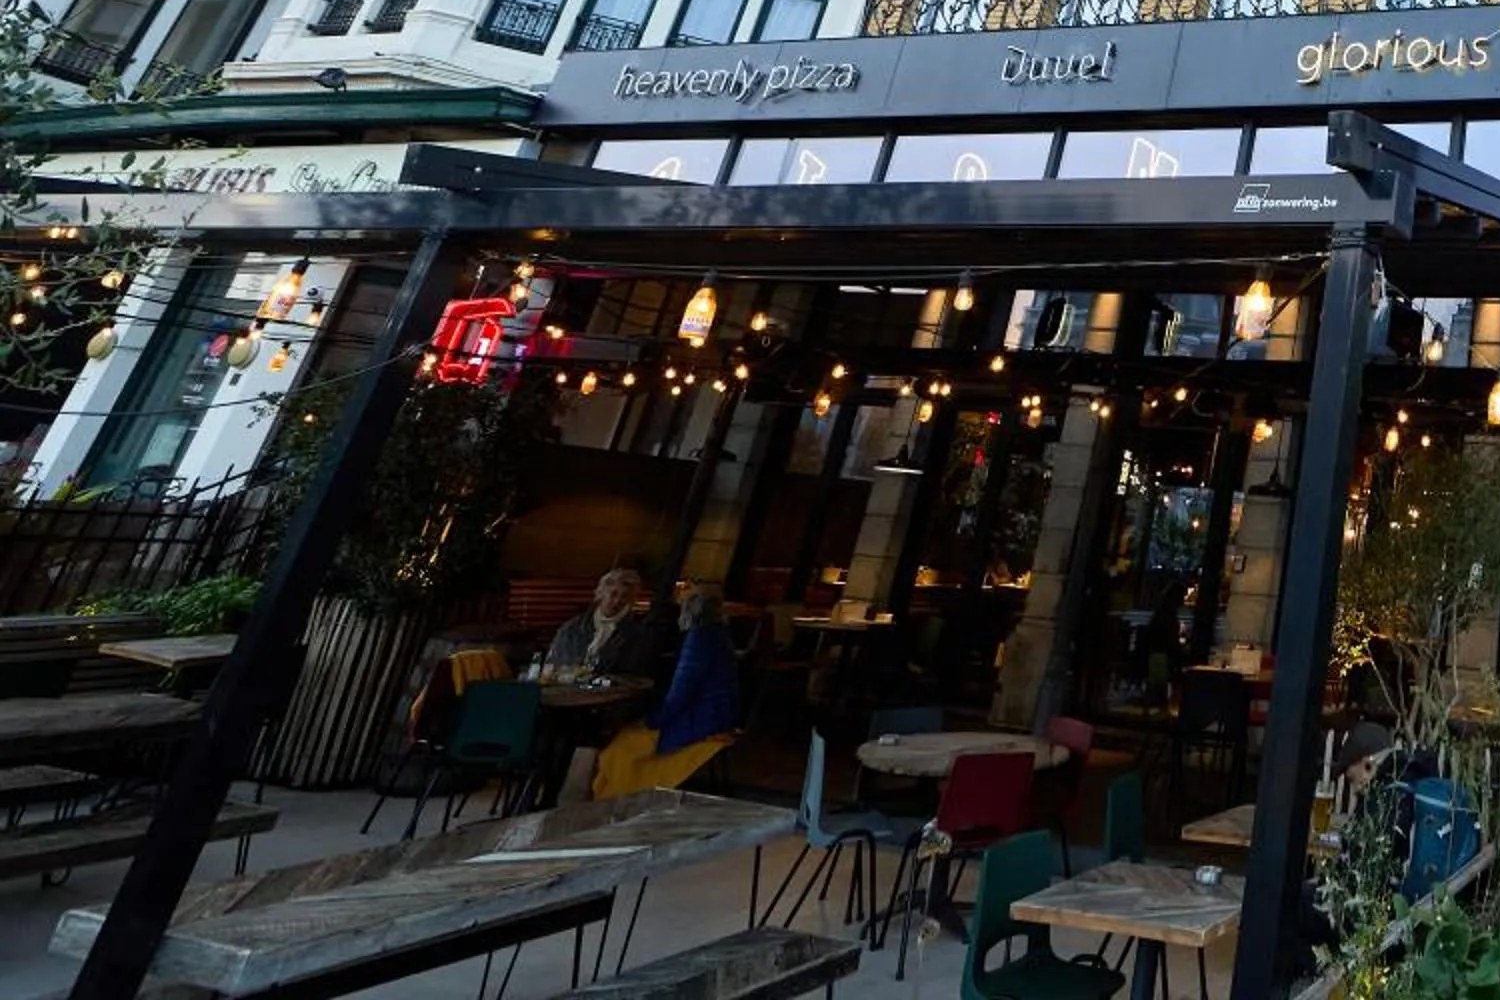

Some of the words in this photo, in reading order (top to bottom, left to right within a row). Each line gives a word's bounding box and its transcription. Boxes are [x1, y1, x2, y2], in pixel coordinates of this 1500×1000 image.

[613, 59, 759, 104] heavenly
[761, 55, 860, 100] pizza
[1297, 28, 1489, 84] glorious
